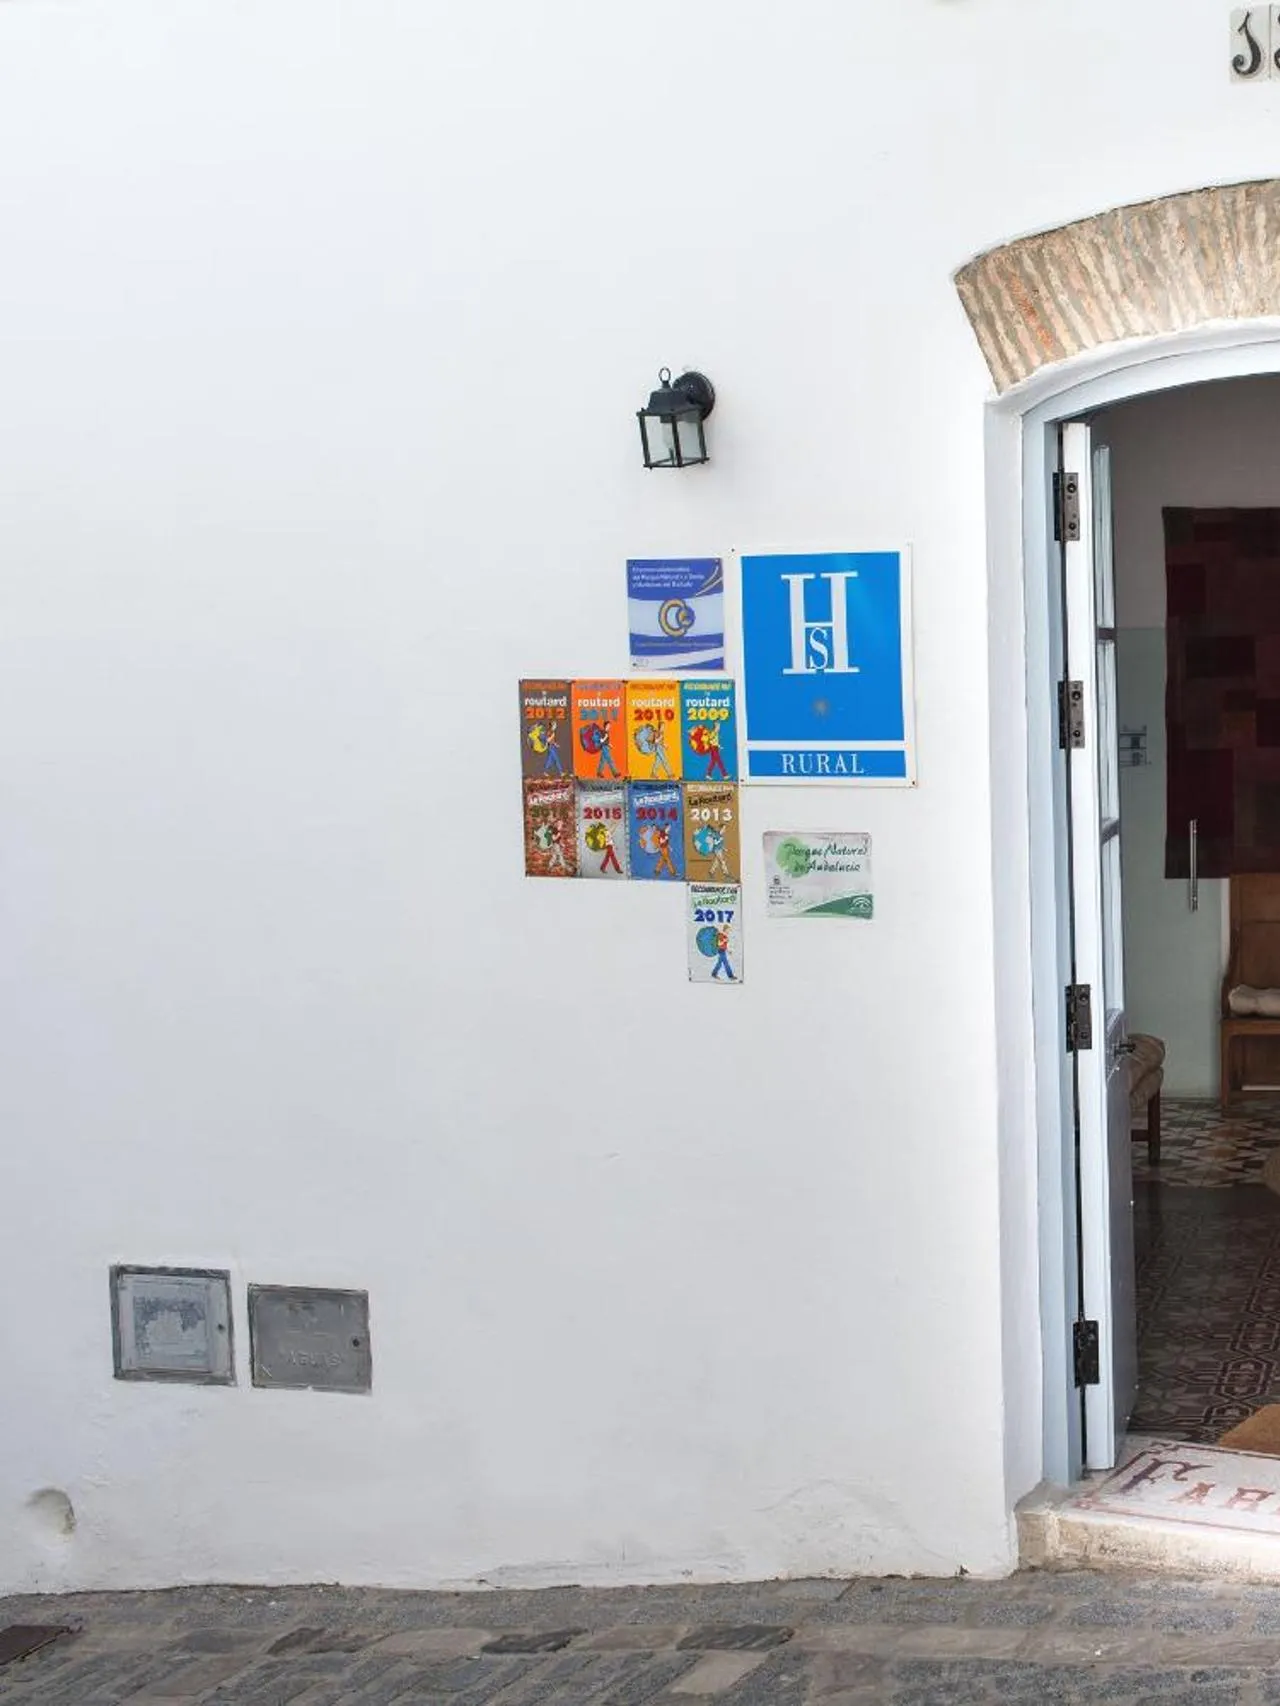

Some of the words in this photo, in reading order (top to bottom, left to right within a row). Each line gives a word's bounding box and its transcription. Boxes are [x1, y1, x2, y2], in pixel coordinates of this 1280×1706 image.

[525, 697, 567, 706] routard
[578, 697, 620, 707] routard
[686, 697, 730, 707] routard
[526, 707, 565, 719] 2012
[634, 709, 674, 720] 2010
[687, 708, 728, 720] 2009
[781, 754, 864, 774] RURAL
[690, 808, 732, 821] 2013
[694, 908, 734, 922] 2017
